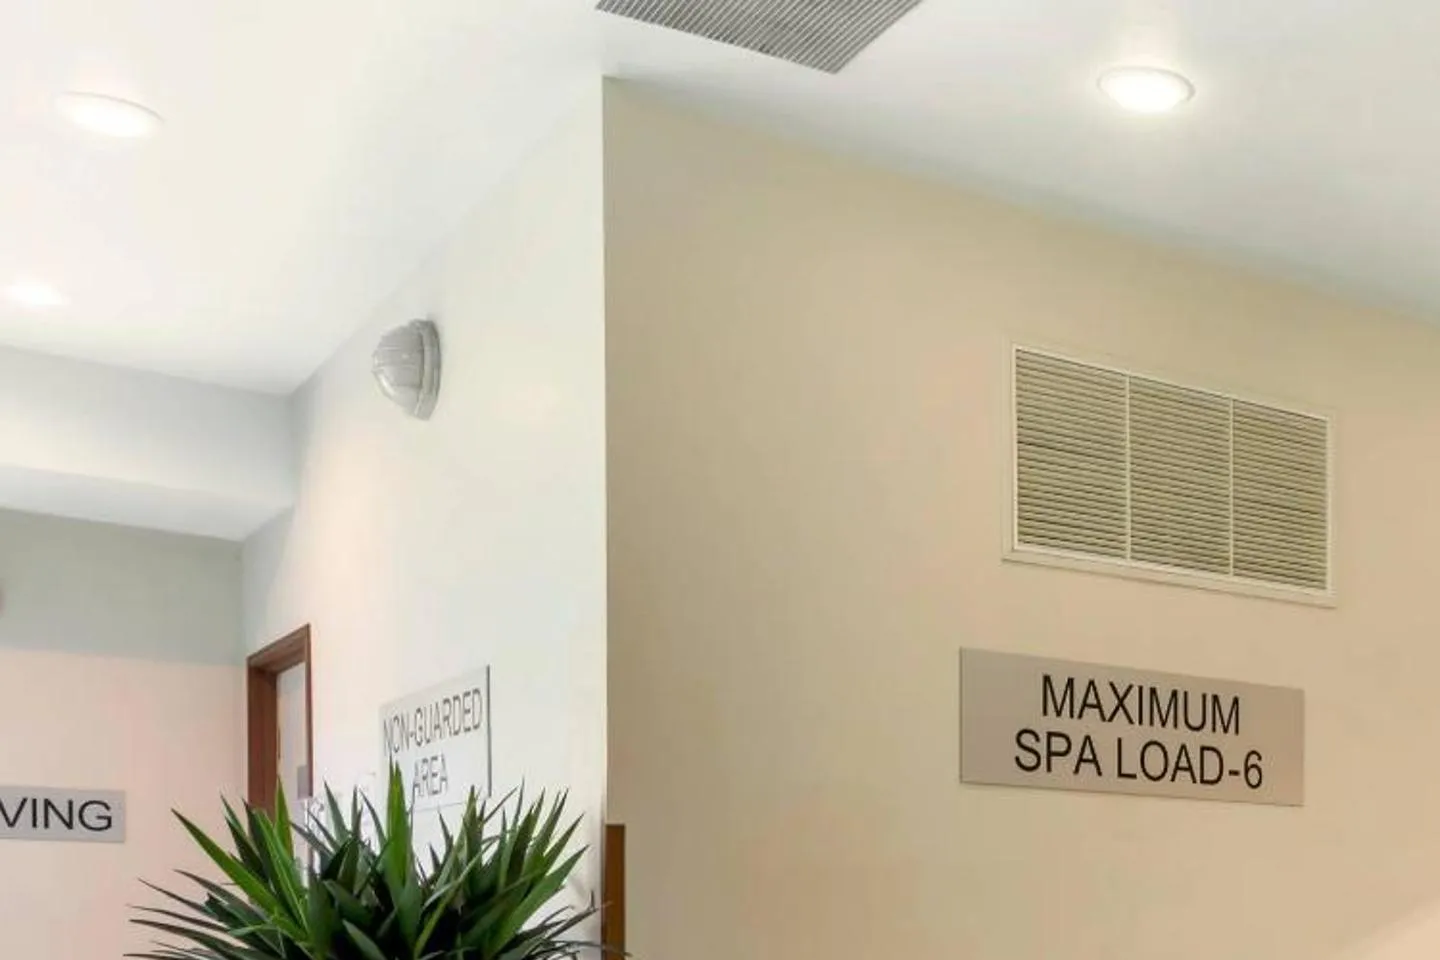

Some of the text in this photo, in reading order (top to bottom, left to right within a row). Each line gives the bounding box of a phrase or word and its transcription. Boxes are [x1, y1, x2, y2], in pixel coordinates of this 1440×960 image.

[383, 688, 482, 756] NON-GUARDED
[1042, 674, 1240, 736] MAXIMUM
[413, 753, 448, 798] AREA
[1014, 728, 1263, 789] SPA LOAD-6
[0, 797, 112, 832] VING
